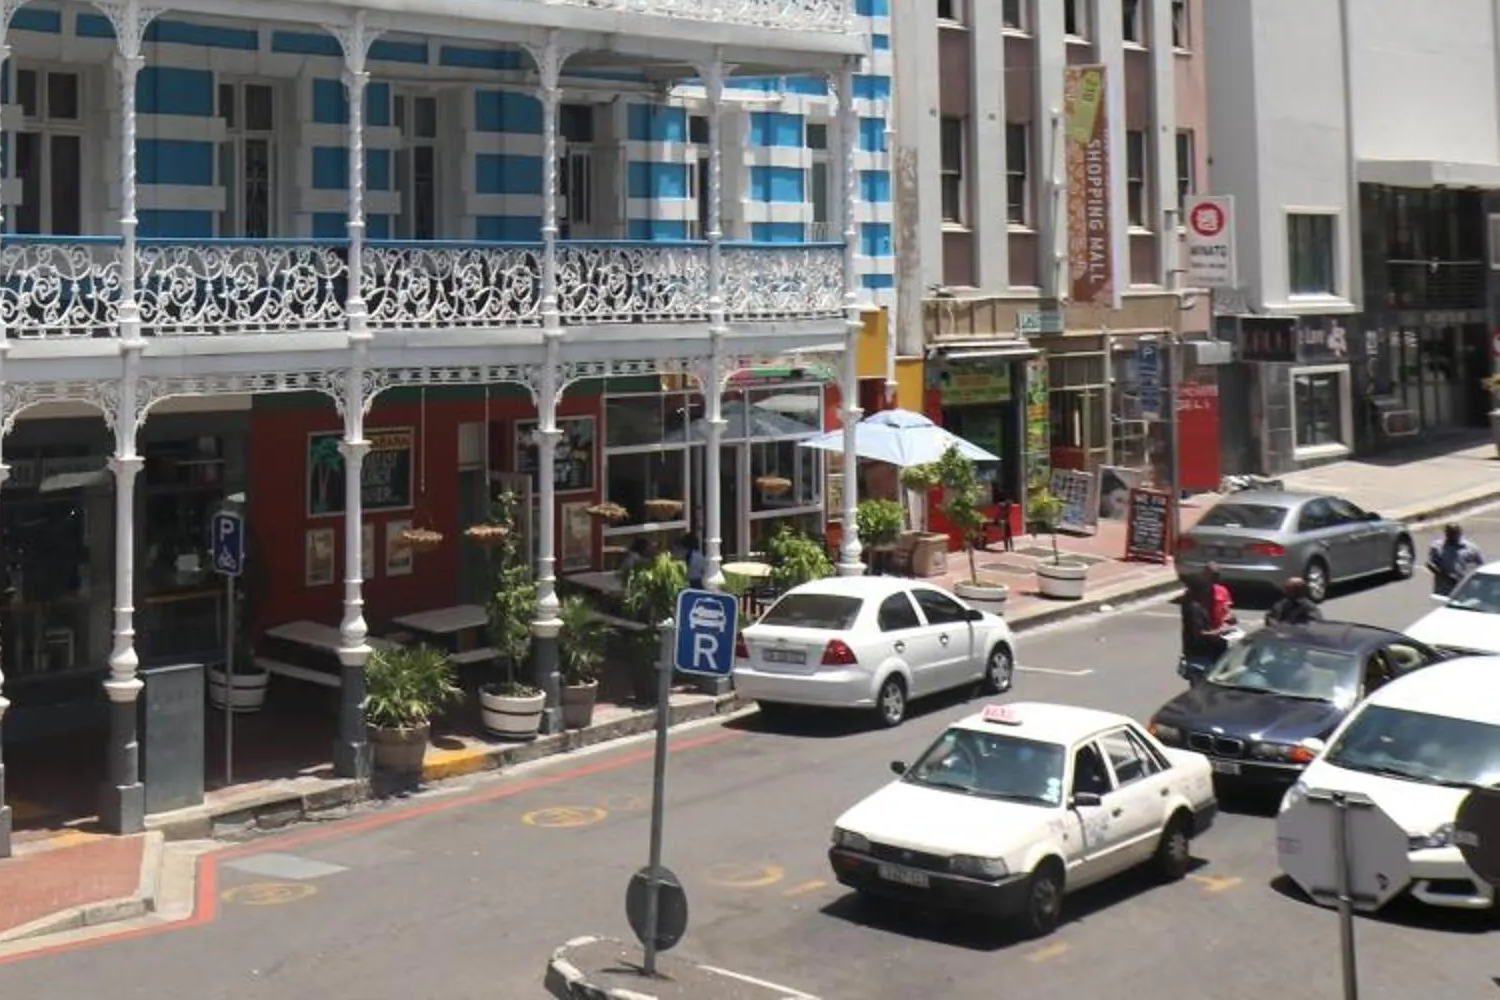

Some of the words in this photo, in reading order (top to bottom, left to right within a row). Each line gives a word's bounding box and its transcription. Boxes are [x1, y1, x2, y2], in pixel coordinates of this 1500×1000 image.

[1087, 139, 1105, 231] SHOPPING
[1089, 237, 1105, 284] MALL
[220, 518, 234, 542] P
[693, 632, 719, 669] R
